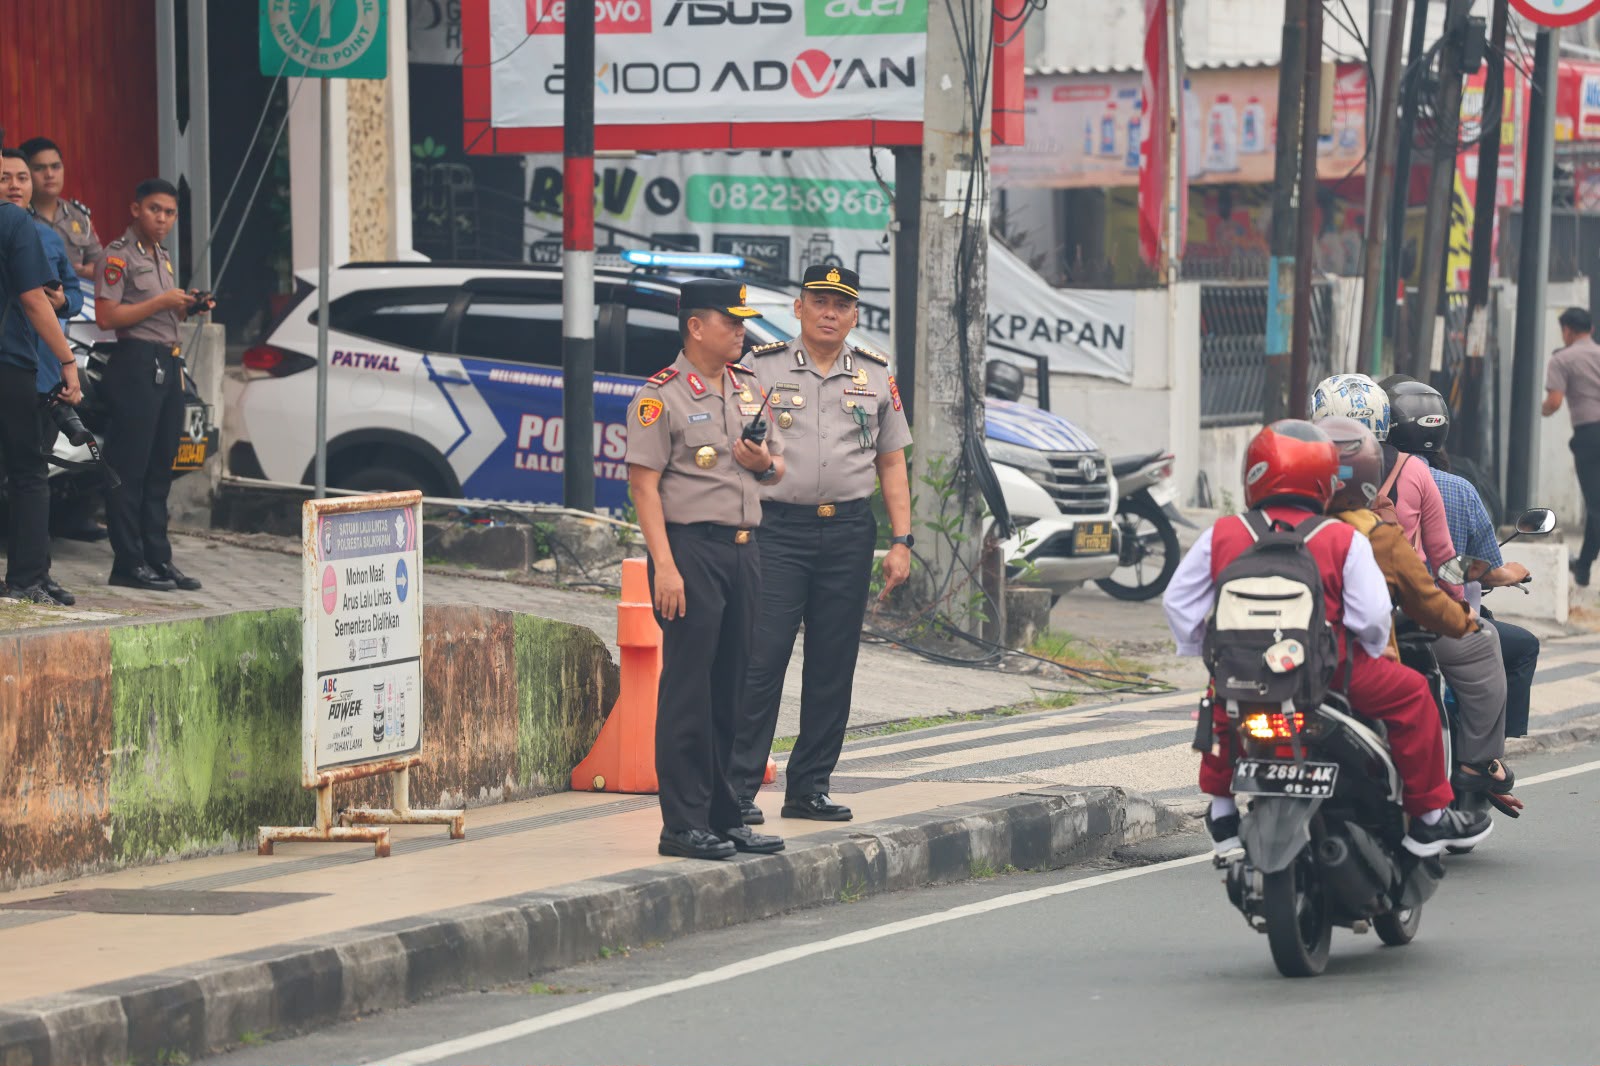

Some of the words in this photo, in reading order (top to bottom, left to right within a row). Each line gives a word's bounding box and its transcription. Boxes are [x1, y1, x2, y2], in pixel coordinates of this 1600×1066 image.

[535, 0, 642, 22] Leovo
[664, 0, 792, 27] ASUS
[276, 23, 329, 65] MUSTER
[333, 25, 370, 63] POINT
[710, 48, 916, 99] ADVAN
[708, 182, 894, 215] 082256960
[731, 241, 779, 257] KING
[331, 350, 400, 371] PATWAL
[346, 567, 369, 586] Mohon
[343, 593, 359, 611] Arus
[360, 591, 373, 609] Lalu
[373, 588, 392, 607] Lintas
[334, 617, 372, 637] Sementara
[372, 612, 400, 632] Dialihkan
[323, 678, 337, 693] ABC
[328, 700, 362, 721] POWER
[1237, 762, 1259, 777] KT
[1312, 766, 1334, 781] AK
